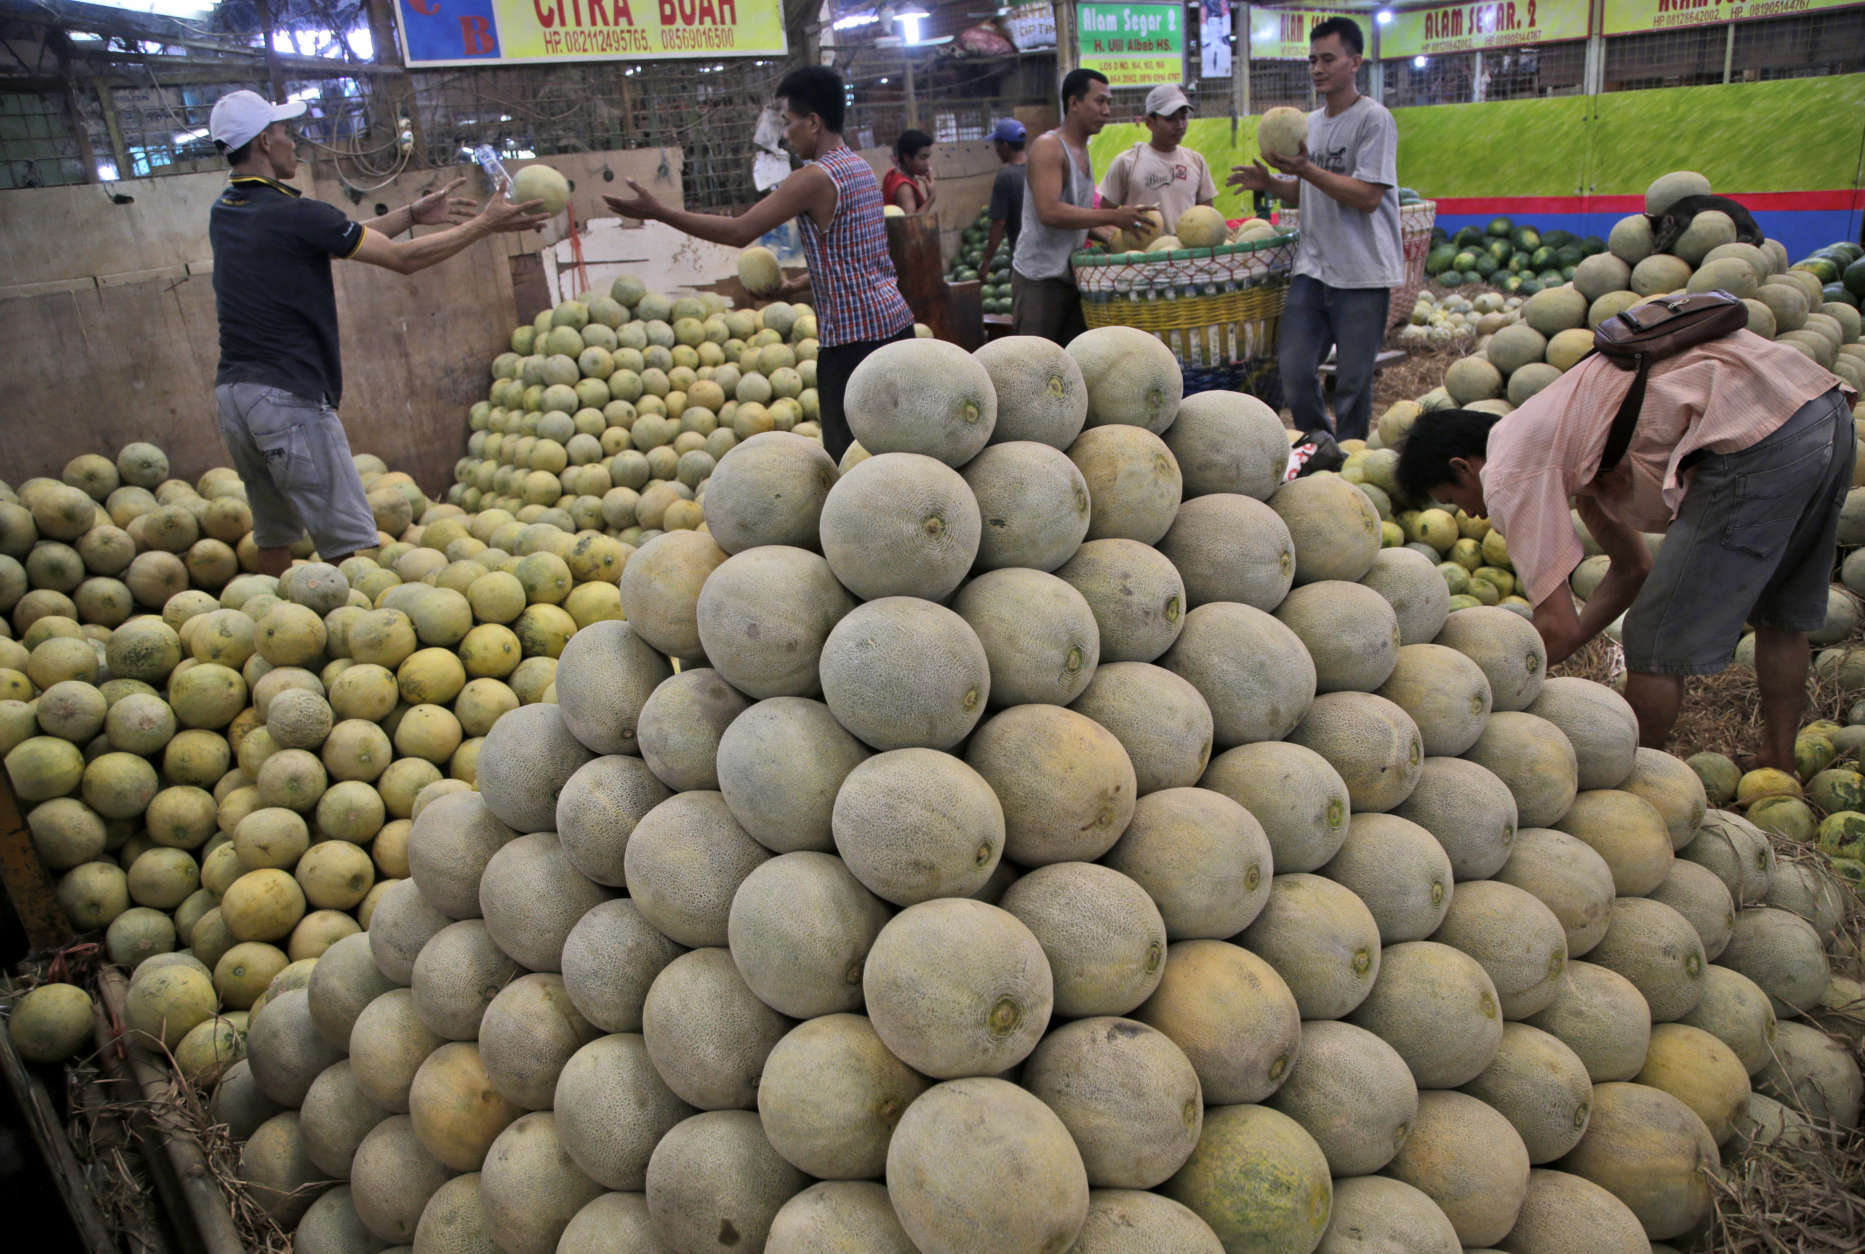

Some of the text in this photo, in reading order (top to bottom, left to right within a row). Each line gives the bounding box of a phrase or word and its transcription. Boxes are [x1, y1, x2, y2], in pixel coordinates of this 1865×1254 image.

[457, 15, 495, 56] B
[1083, 8, 1177, 37] Alam Segar 2
[1425, 8, 1463, 40] ALAM
[1527, 0, 1537, 28] 2
[661, 27, 736, 51] 08569016500
